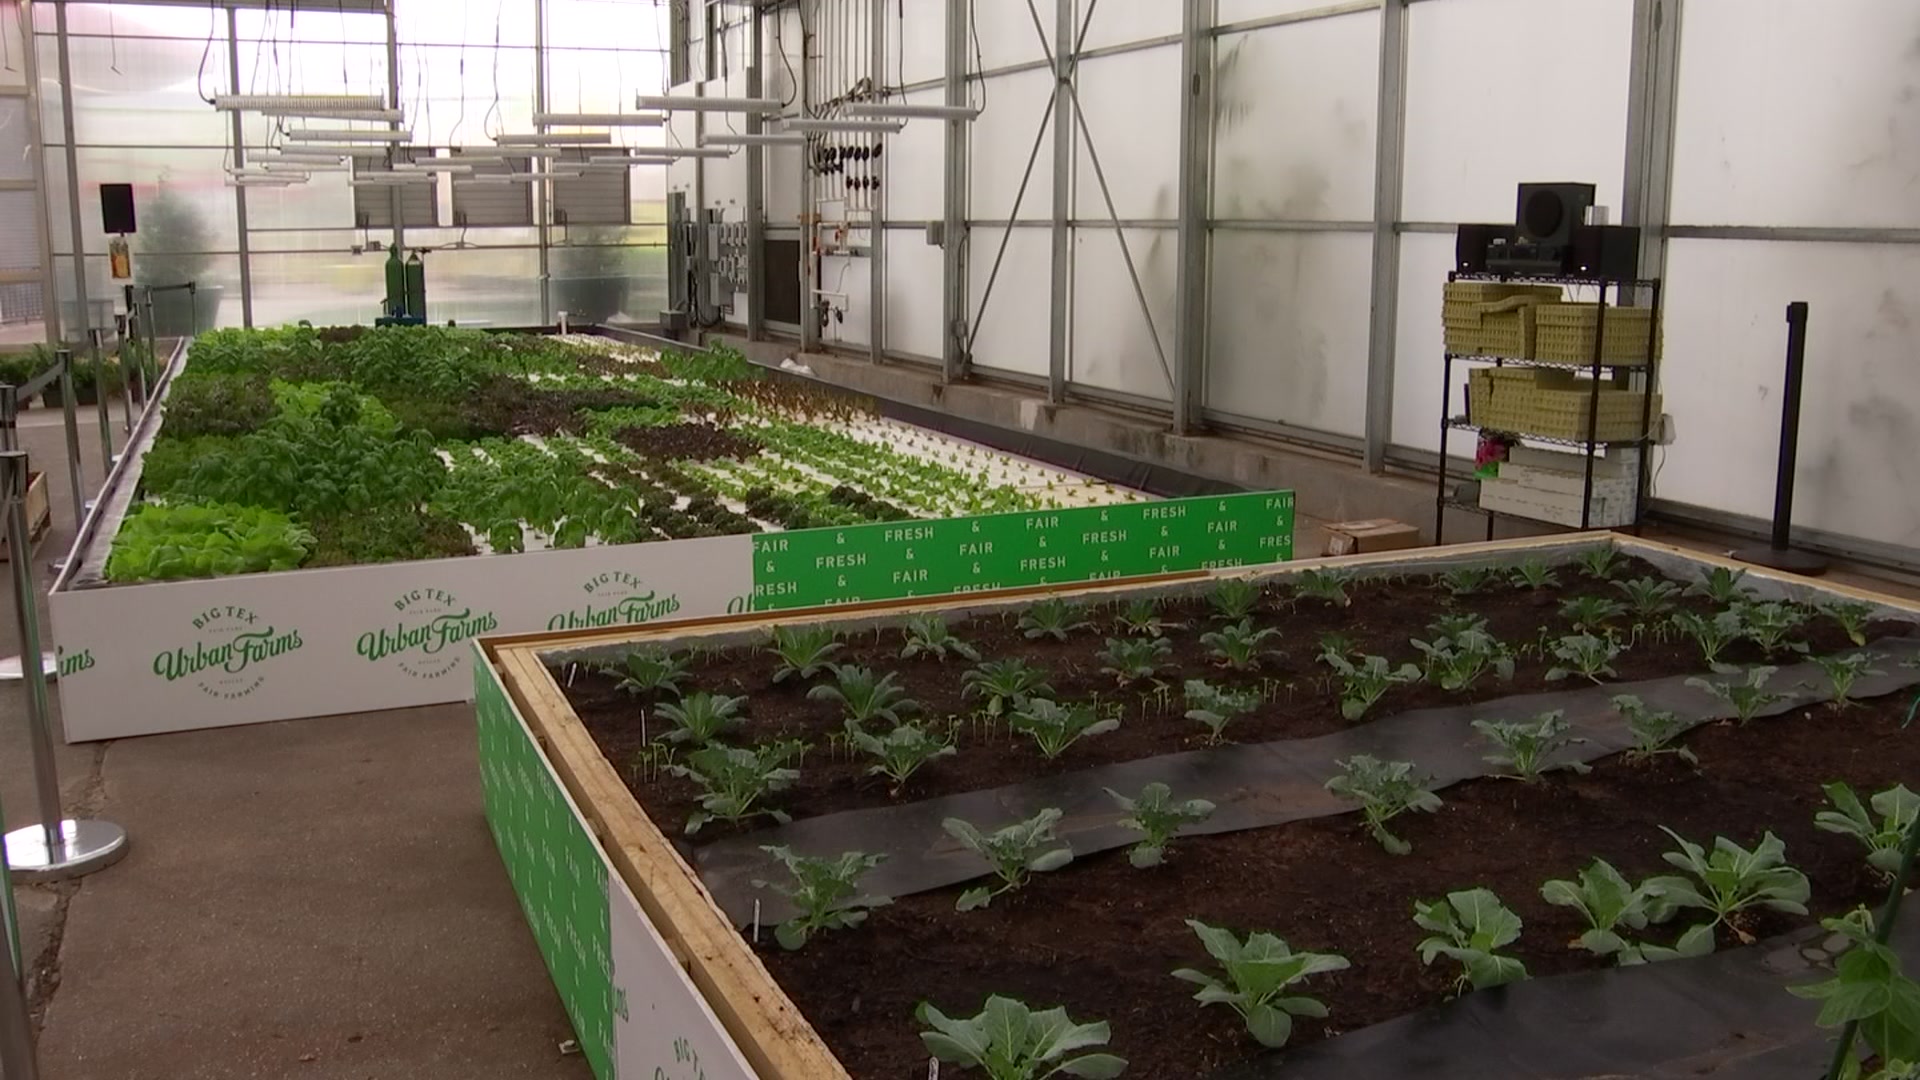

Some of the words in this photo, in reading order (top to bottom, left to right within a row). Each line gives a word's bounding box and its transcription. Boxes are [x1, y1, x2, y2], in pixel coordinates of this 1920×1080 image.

[1143, 505, 1186, 520] FRESH
[1026, 516, 1059, 530] FAIR
[1208, 520, 1237, 533] FAIR
[885, 527, 934, 542] FRESH
[1082, 530, 1127, 545] FRESH
[753, 539, 788, 553] FAIR
[959, 542, 993, 556] FAIR
[1150, 545, 1180, 558] FAIR
[816, 553, 866, 569] FRESH
[1020, 556, 1066, 572] FRESH
[584, 573, 609, 593] BIG
[614, 571, 642, 589] TEX
[893, 569, 928, 584] FAIR
[394, 590, 421, 611] BIG
[426, 588, 456, 606] TEX
[618, 590, 680, 624] Farms
[192, 607, 221, 629] BIG
[225, 606, 258, 625] TEX
[357, 623, 431, 661] Urban
[423, 608, 498, 654] Farms
[153, 641, 233, 681] Urban
[224, 626, 303, 673] Farms
